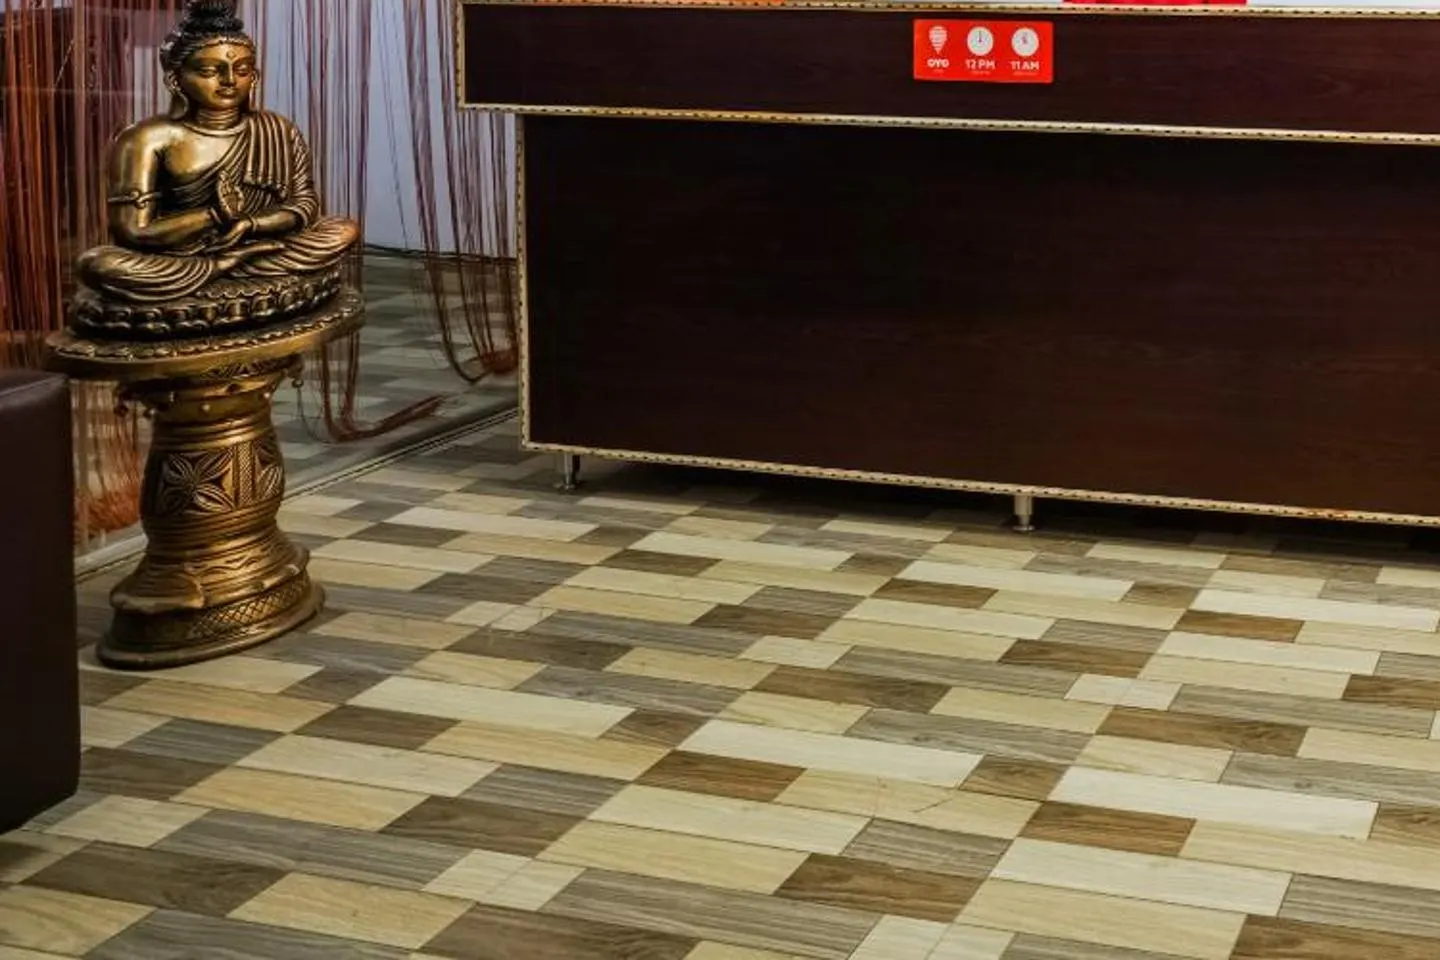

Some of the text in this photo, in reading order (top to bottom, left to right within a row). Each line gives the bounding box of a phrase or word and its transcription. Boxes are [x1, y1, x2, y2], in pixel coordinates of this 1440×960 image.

[927, 58, 950, 68] OYO
[966, 59, 996, 70] 12 PM
[1010, 61, 1040, 71] 11 AM
